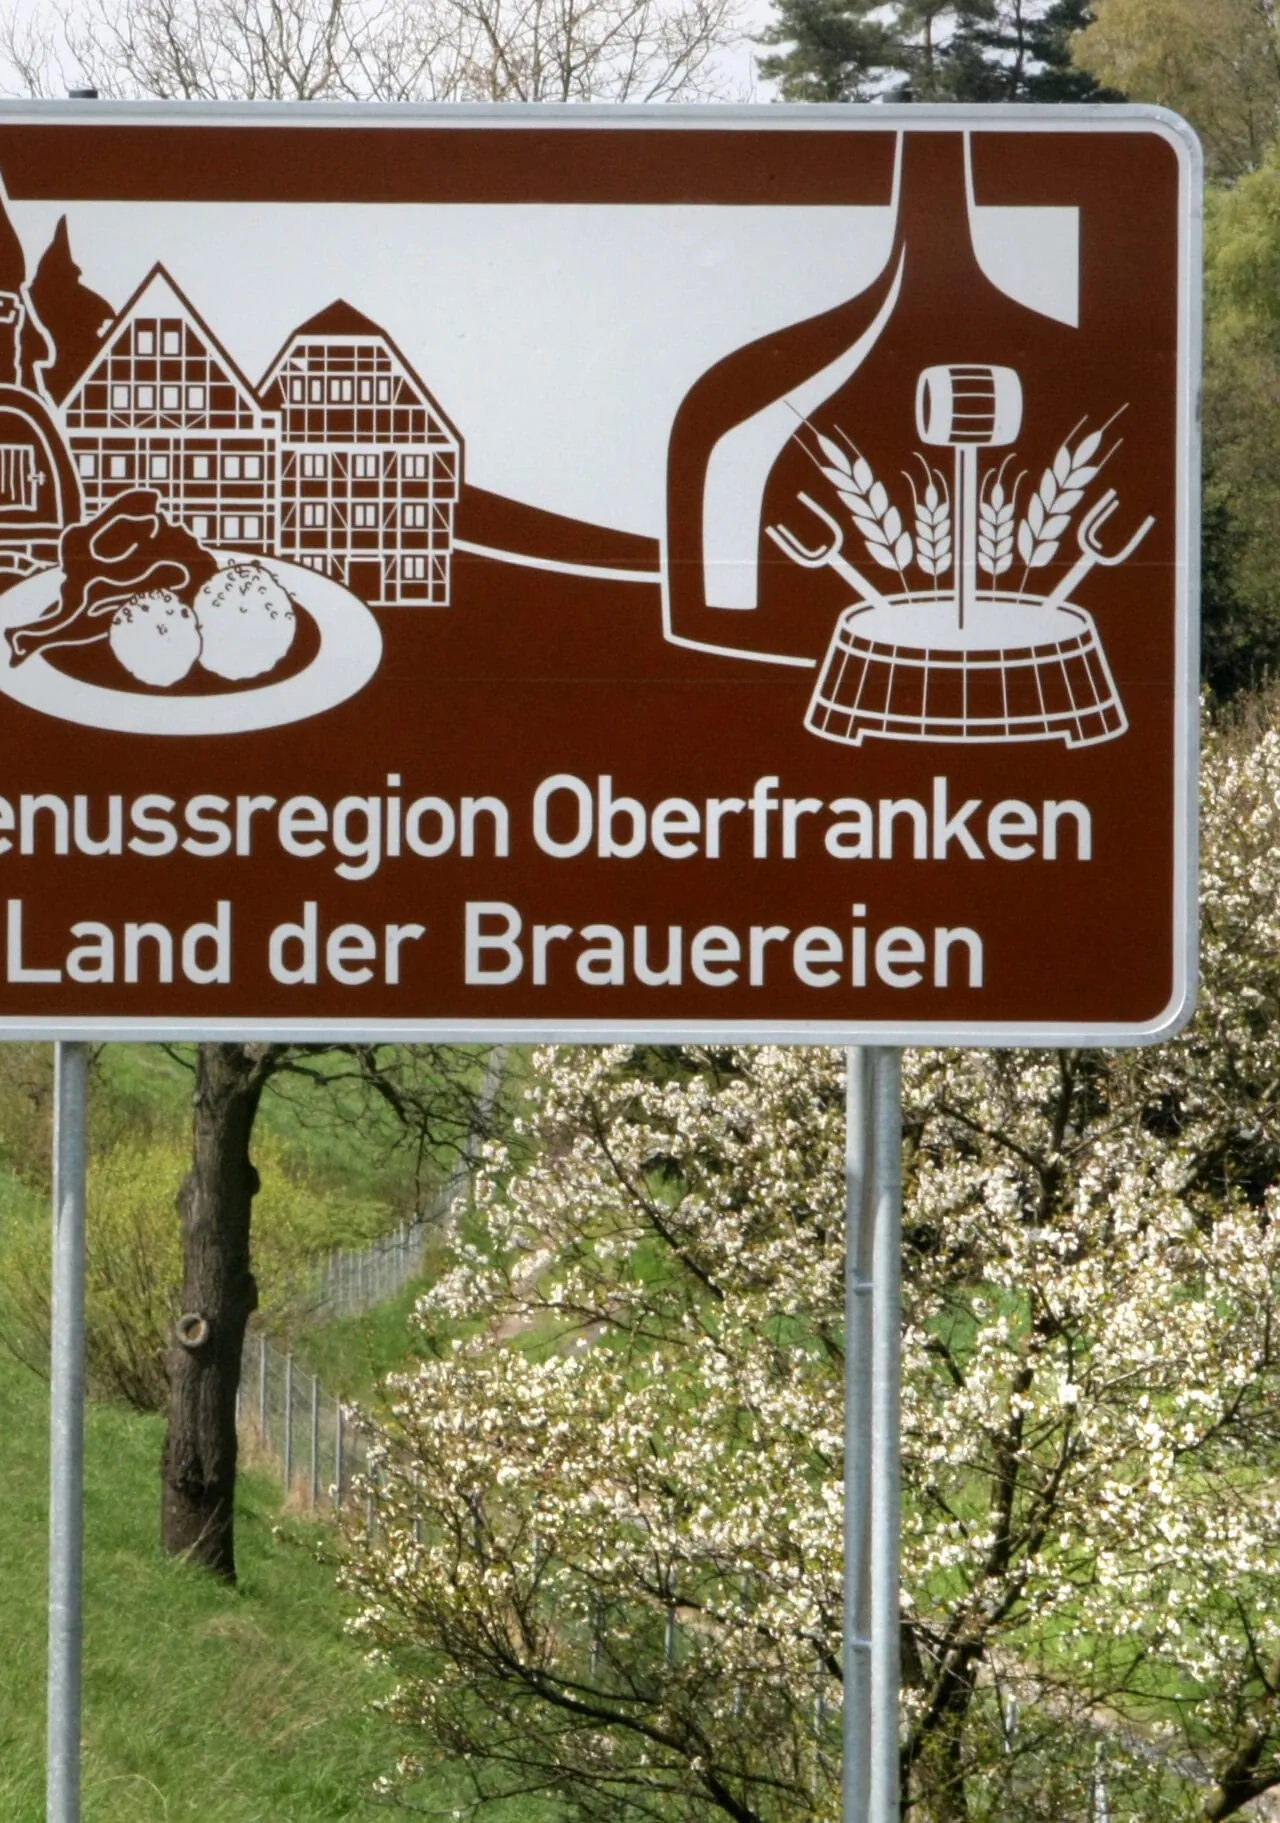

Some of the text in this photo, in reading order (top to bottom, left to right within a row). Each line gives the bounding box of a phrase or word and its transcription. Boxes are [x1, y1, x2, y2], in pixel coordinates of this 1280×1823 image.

[533, 774, 1092, 861] Oberfranken
[7, 899, 983, 988] Land der Brauereien
